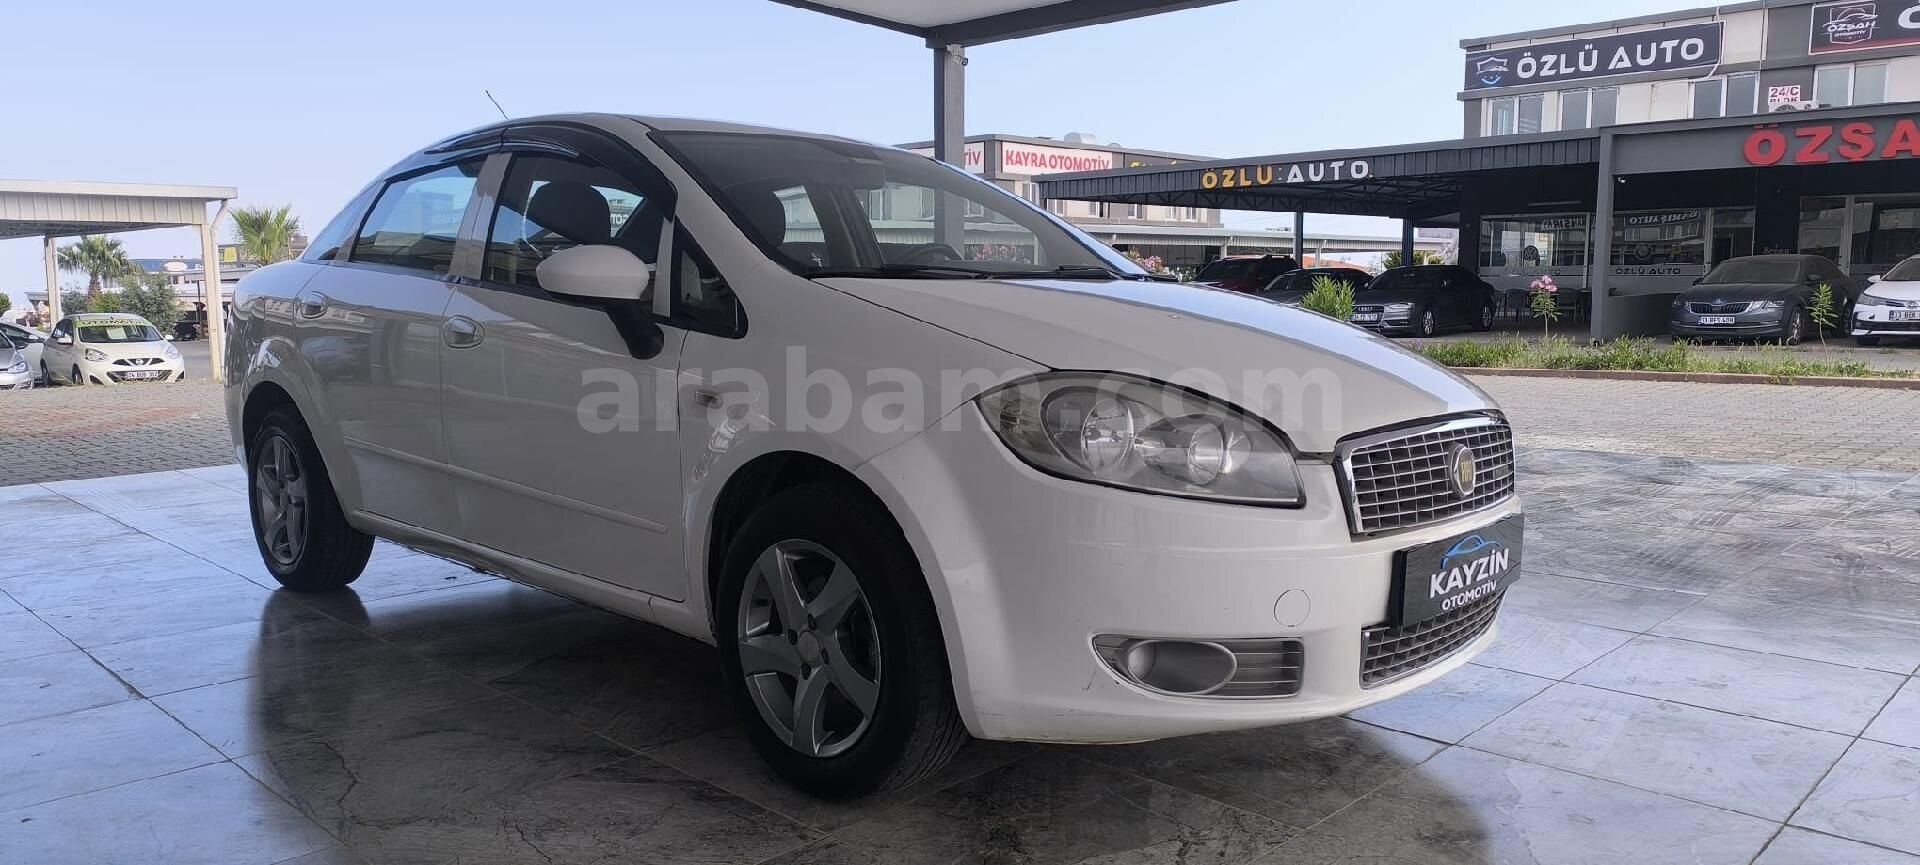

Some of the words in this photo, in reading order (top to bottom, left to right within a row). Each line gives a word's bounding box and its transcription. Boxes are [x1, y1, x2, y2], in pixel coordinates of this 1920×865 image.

[1827, 22, 1876, 33] ÖZŞAH
[1516, 44, 1599, 79] ÖZLÜ
[1608, 37, 1704, 70] AUTO
[1770, 86, 1799, 97] 24/C
[1005, 149, 1047, 168] KAYRA
[1048, 154, 1109, 172] OTOMOTİV
[1202, 165, 1273, 189] ÖZLÜ
[1287, 160, 1370, 183] AUTO
[1429, 548, 1509, 598] KAYZİN
[1442, 580, 1497, 610] OTOMOTİV
